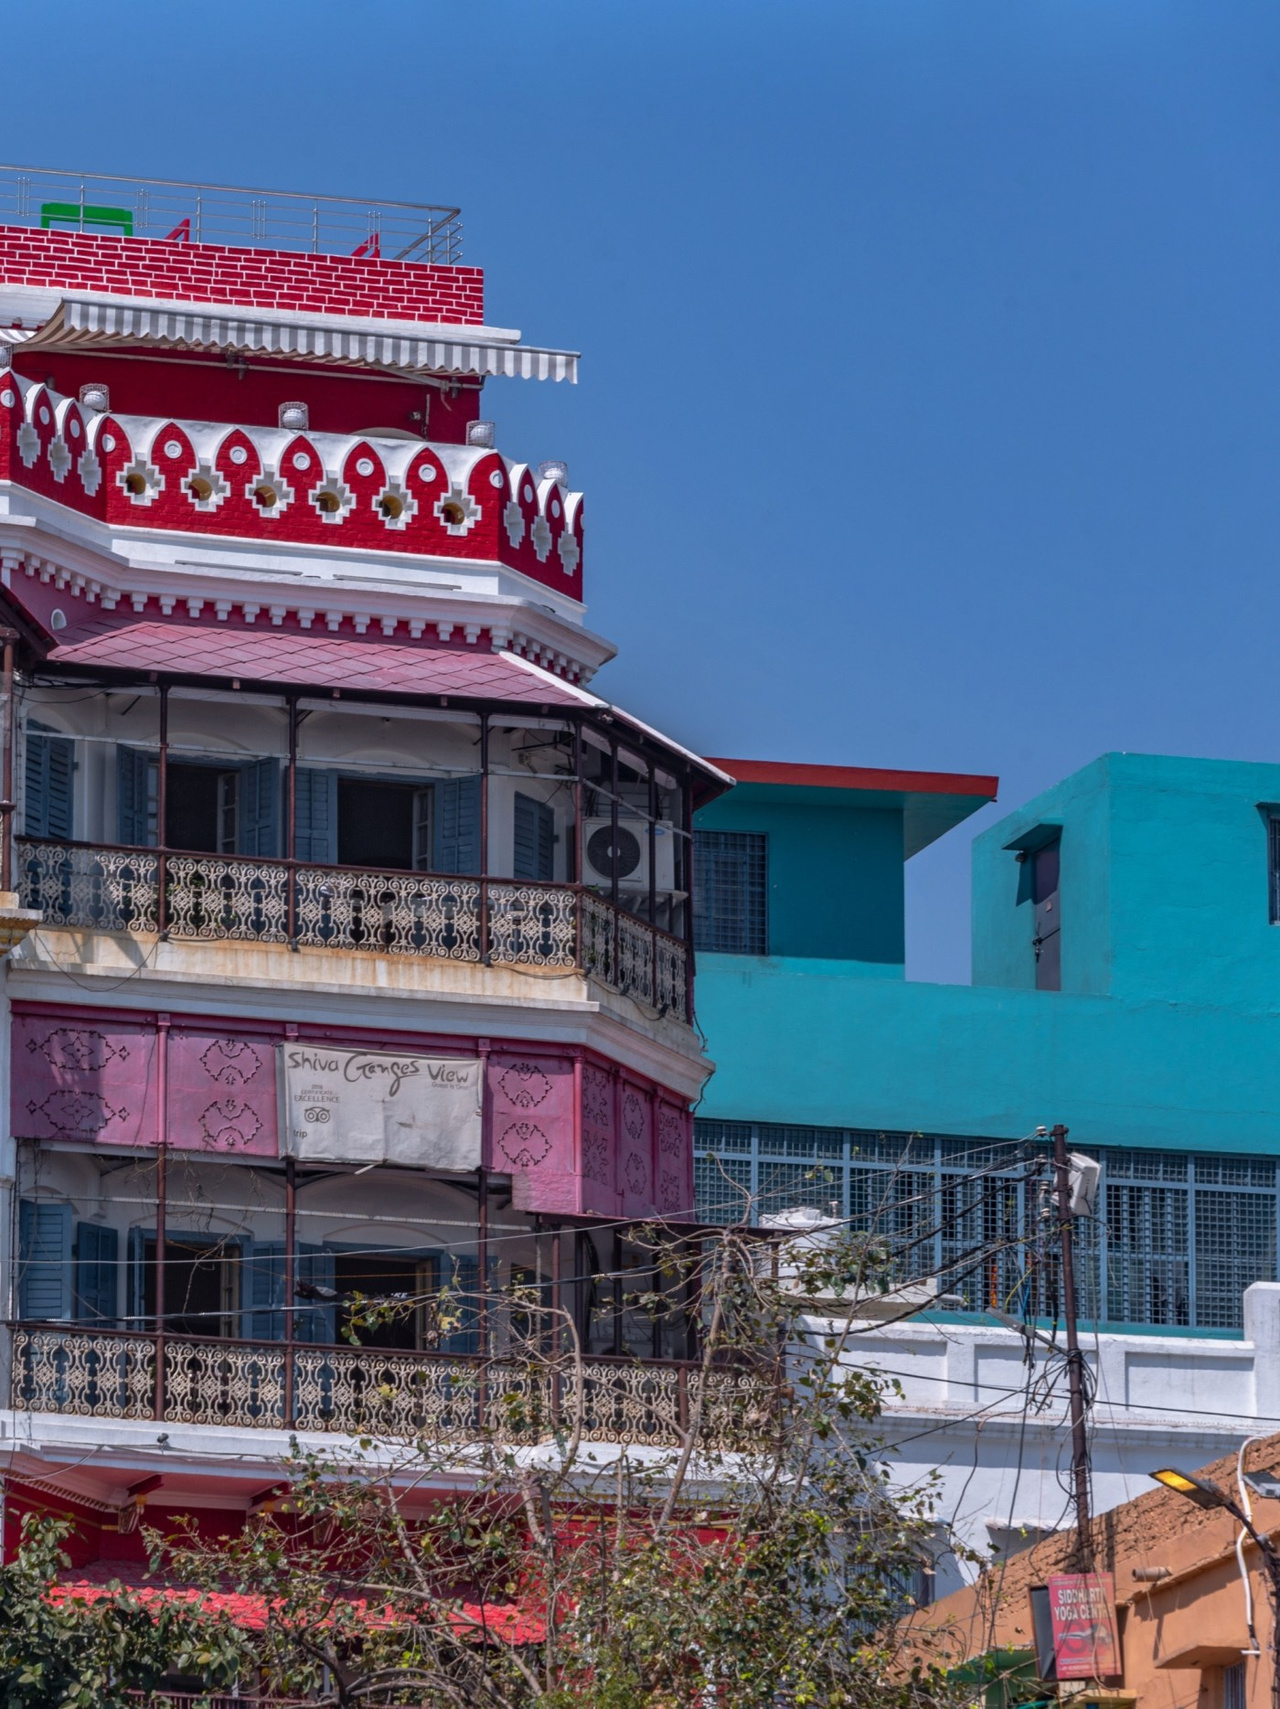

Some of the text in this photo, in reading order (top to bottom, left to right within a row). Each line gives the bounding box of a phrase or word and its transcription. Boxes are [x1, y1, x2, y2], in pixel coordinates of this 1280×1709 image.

[287, 1051, 469, 1098] Shiva Ganges View
[293, 1095, 341, 1103] EXCELLENCE
[1054, 1604, 1079, 1621] YOGA
